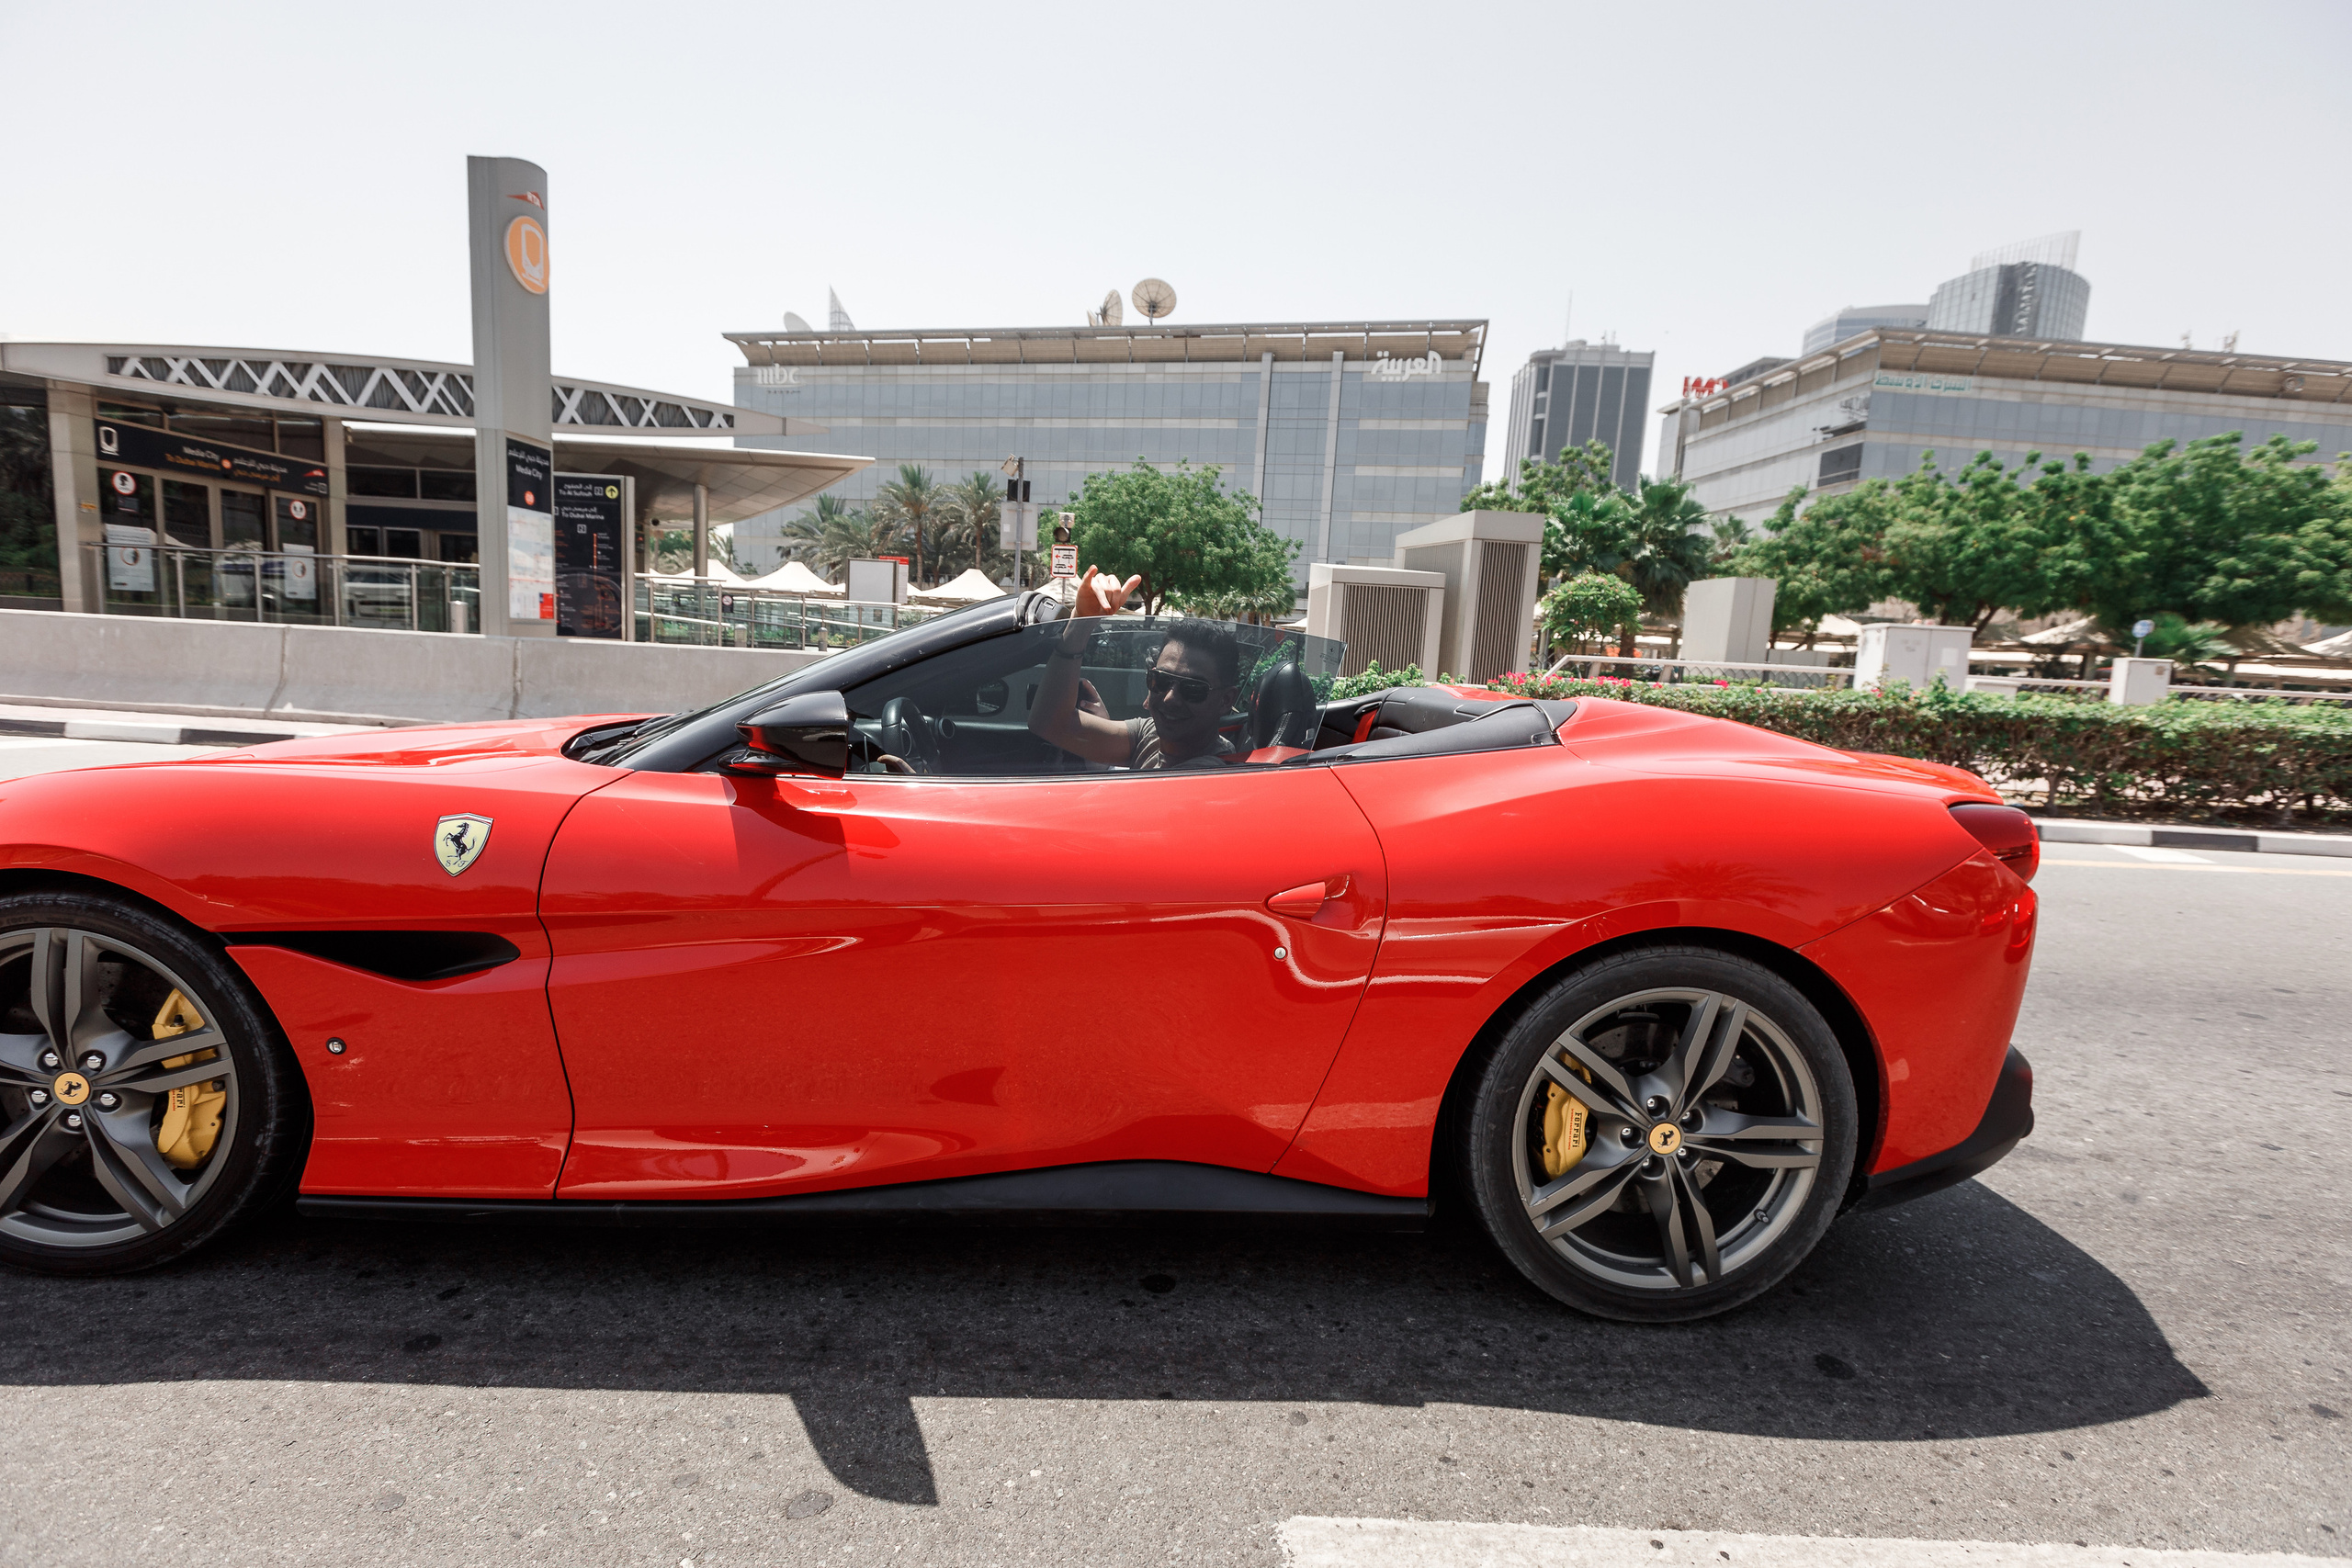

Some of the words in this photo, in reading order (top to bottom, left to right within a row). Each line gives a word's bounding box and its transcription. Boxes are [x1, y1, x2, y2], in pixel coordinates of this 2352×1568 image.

[755, 363, 801, 385] mbc
[1371, 350, 1442, 382] العربية
[1572, 1112, 1582, 1148] Ferrari
